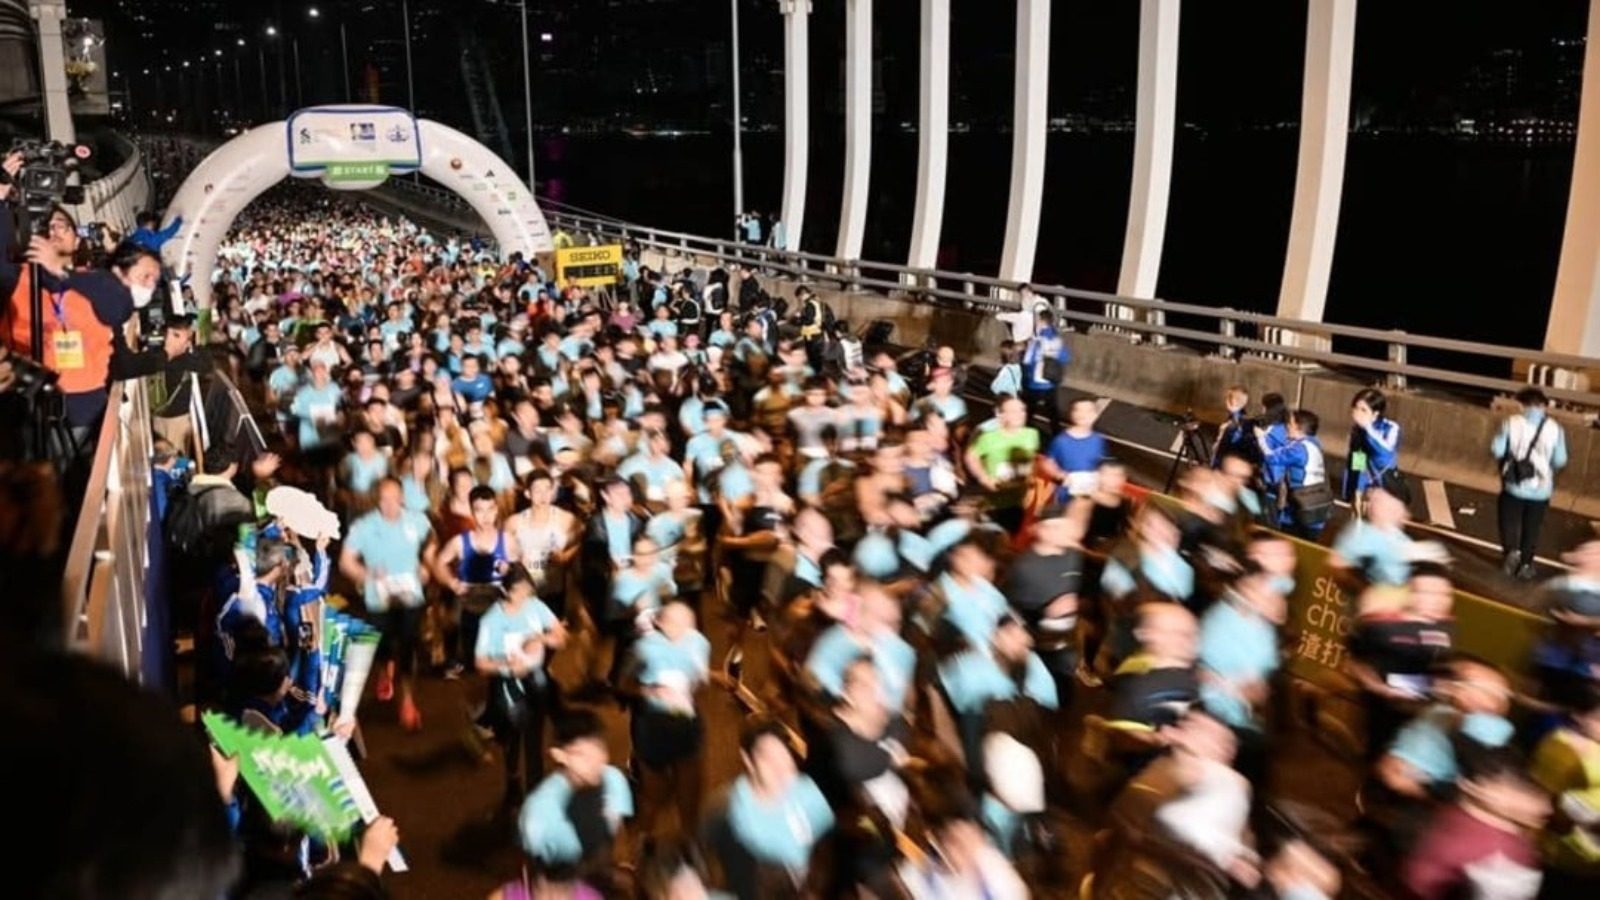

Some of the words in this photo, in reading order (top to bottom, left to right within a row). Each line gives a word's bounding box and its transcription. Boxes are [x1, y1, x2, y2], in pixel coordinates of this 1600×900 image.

[344, 165, 374, 175] START
[569, 250, 611, 262] SEIKO
[1297, 629, 1345, 668] 渣打
